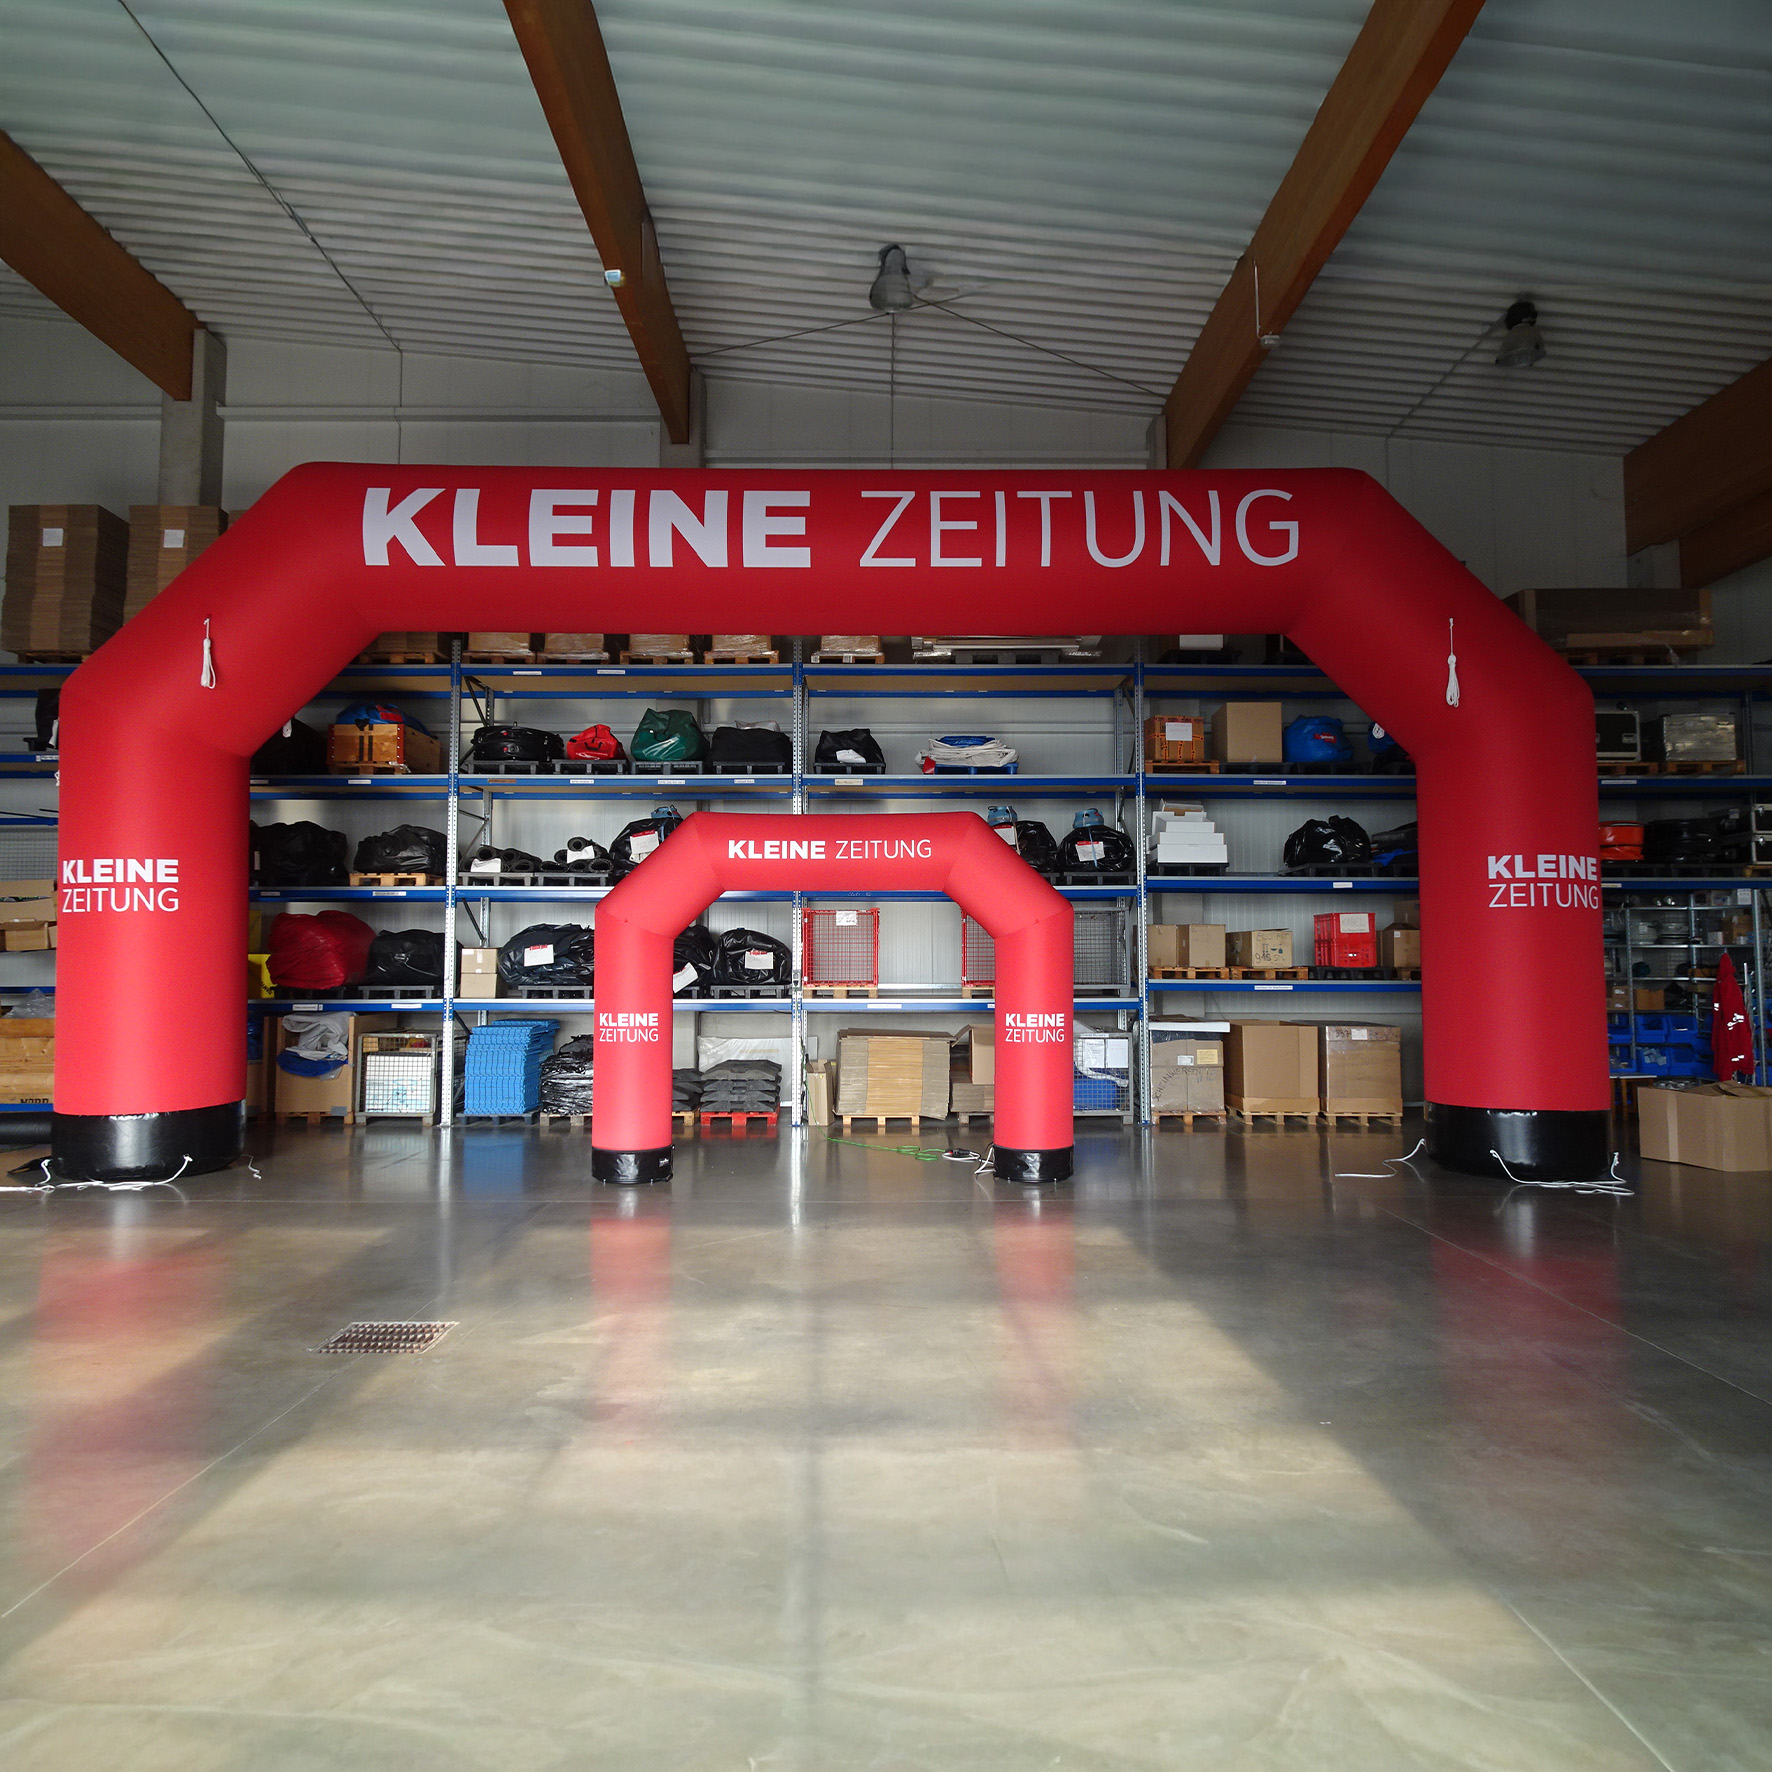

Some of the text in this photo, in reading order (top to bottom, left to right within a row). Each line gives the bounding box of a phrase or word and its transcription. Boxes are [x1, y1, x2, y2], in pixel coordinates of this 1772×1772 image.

[362, 487, 1299, 569] KLEINE ZEITUNG
[728, 839, 932, 860] KLEINE ZEITUNG
[62, 858, 179, 884] KLEINE
[1487, 854, 1598, 881] KLEINE
[62, 887, 179, 913] ZEITUNG
[1488, 882, 1599, 910] ZEITUNG
[599, 1012, 659, 1028] KLEINE
[1005, 1012, 1065, 1028] KLEINE
[599, 1028, 659, 1043] ZEITUNG
[1005, 1028, 1065, 1044] ZEITUNG
